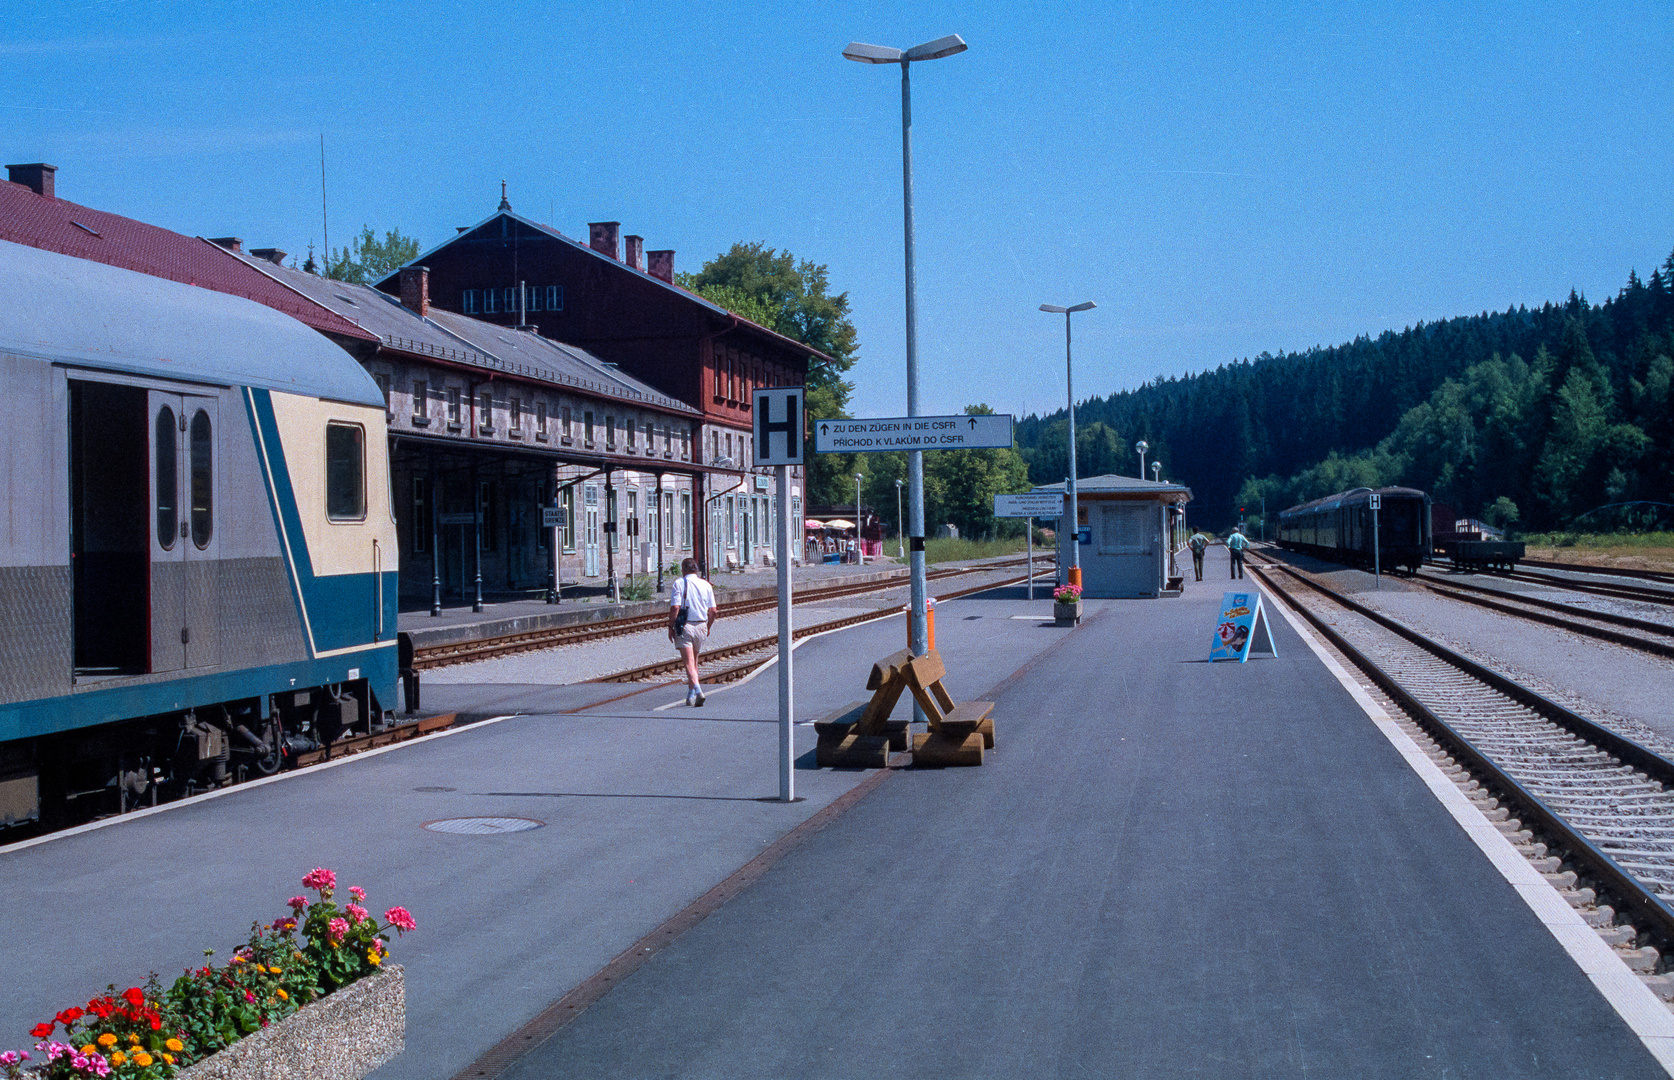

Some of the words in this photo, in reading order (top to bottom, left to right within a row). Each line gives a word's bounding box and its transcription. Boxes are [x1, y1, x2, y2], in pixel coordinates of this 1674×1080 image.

[759, 396, 797, 459] H
[833, 425, 846, 433] ZU
[848, 424, 867, 433] DEN
[869, 422, 900, 432] ZÜGEN
[902, 423, 912, 431] IN
[914, 422, 930, 431] DIE
[931, 421, 956, 430] CSFR
[875, 438, 882, 446] K
[923, 436, 938, 444] DO
[940, 433, 965, 444] ČSFR
[1371, 495, 1379, 508] H
